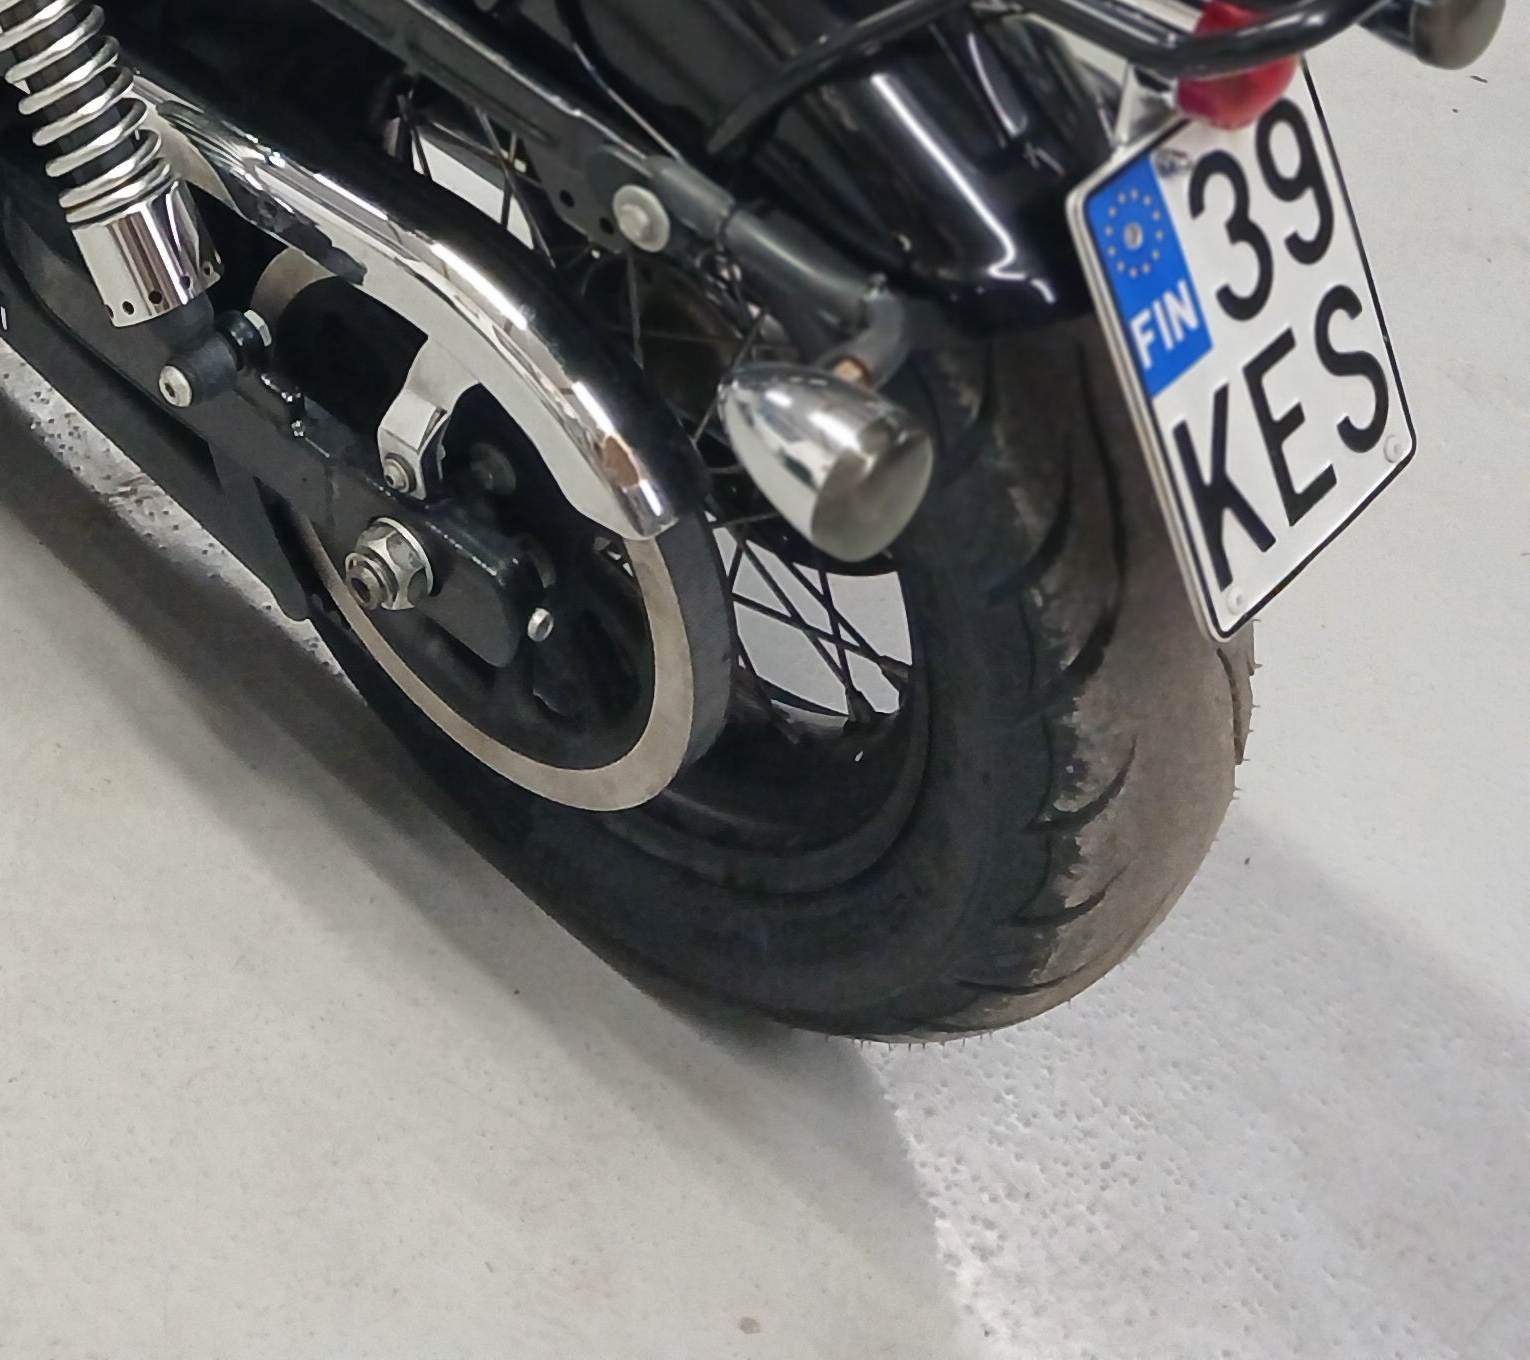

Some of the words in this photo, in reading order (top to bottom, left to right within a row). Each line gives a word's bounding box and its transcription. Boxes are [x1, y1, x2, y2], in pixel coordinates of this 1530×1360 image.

[1188, 97, 1334, 321] 39
[1129, 279, 1199, 371] FIN
[1172, 284, 1390, 592] KES
